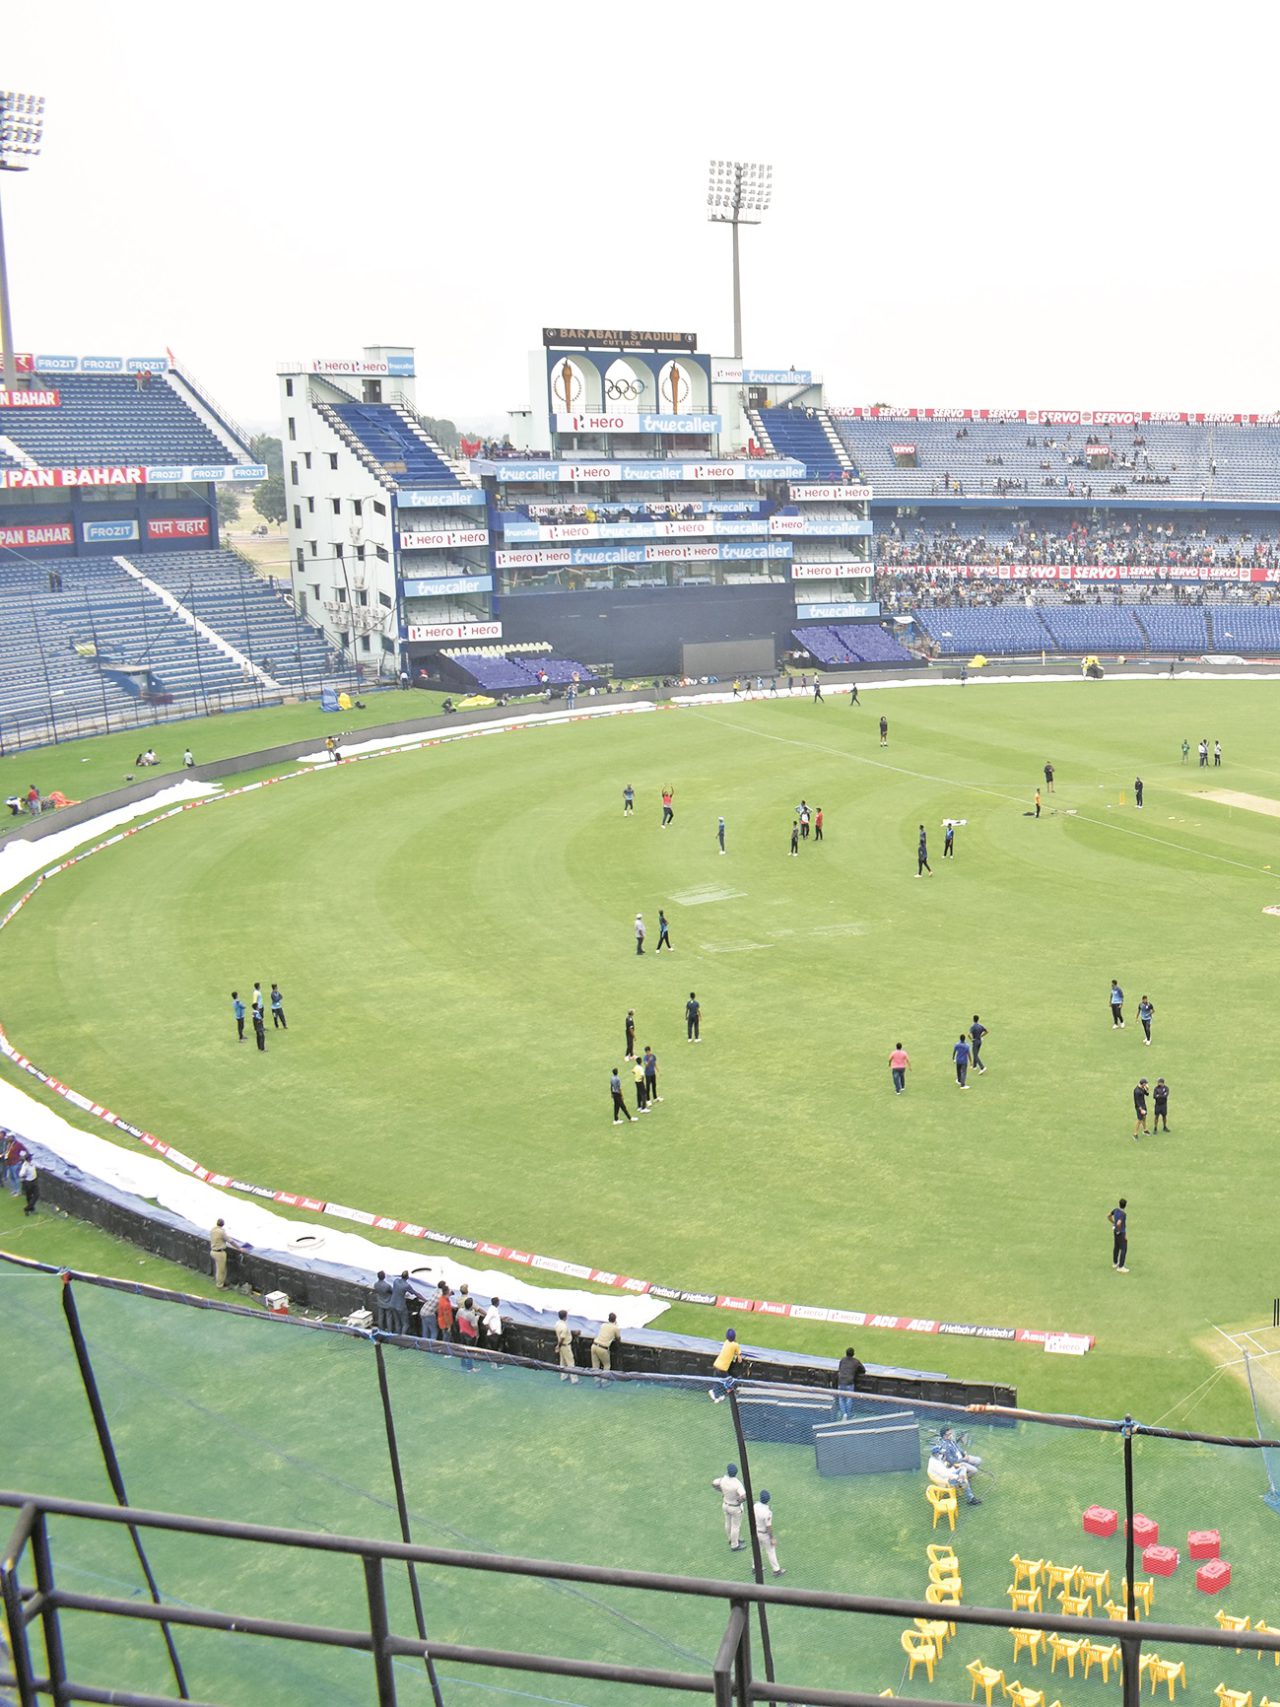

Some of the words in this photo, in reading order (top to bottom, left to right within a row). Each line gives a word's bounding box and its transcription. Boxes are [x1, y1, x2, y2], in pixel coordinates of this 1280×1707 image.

[560, 329, 623, 339] BARABATI
[630, 331, 681, 342] STADIUM
[38, 359, 76, 369] FROZIT
[84, 360, 121, 370] FROZIT
[129, 361, 165, 370] FROZIT
[325, 363, 349, 371] Hero
[363, 363, 387, 372] Hero
[749, 371, 807, 383] truecaller
[13, 391, 56, 405] BAHAR
[829, 408, 855, 417] ERVO
[878, 408, 910, 417] SERVO
[933, 409, 965, 418] SERVO
[988, 410, 1020, 419] SERVO
[1040, 411, 1079, 424] SERVO
[1095, 412, 1134, 424] SERVO
[1149, 412, 1180, 421] SERVO
[1203, 413, 1234, 422] SERVO
[590, 418, 624, 428] Hero
[644, 416, 718, 432] truecaller
[893, 446, 915, 454] SERVO
[1086, 447, 1109, 455] SERVO
[8, 469, 54, 487] PAN
[62, 467, 144, 485] BAHAR
[151, 470, 183, 480] FROZIT
[193, 469, 224, 479] FROZIT
[234, 468, 265, 478] FROZIT
[499, 467, 557, 481] truecaller
[584, 468, 610, 477] Hero
[624, 466, 681, 480] truecaller
[707, 467, 734, 476] Hero
[748, 465, 805, 478] truecaller
[805, 489, 829, 497] Hero
[845, 488, 870, 497] Hero
[411, 491, 473, 506] truecaller
[678, 523, 705, 532] Hero
[782, 521, 803, 529] Hero
[804, 522, 861, 534] truecaller
[0, 531, 24, 545] PAN
[27, 527, 71, 543] BAHAR
[90, 526, 131, 538] FROZIT
[562, 527, 589, 536] Hero
[600, 524, 655, 539] truecaller
[417, 534, 444, 544] Hero
[460, 532, 486, 542] Hero
[509, 553, 533, 562] Hero
[546, 551, 570, 561] Hero
[575, 548, 643, 564] truecaller
[657, 548, 681, 557] Hero
[694, 546, 718, 555] Hero
[722, 544, 790, 558] truecaller
[807, 567, 832, 575] Hero
[847, 566, 871, 575] Hero
[1013, 567, 1056, 578] SERVO
[1073, 567, 1117, 579] SERVO
[1169, 567, 1198, 577] SERVO
[1209, 568, 1238, 577] SERVO
[417, 580, 480, 595] truecaller
[809, 604, 868, 617] truecaller
[425, 626, 454, 637] Hero
[471, 625, 499, 635] Hero
[592, 1271, 617, 1285] ACC
[722, 1297, 748, 1309] Amul
[759, 1301, 785, 1313] Amul
[868, 1315, 898, 1328] ACC
[906, 1319, 935, 1332] ACC
